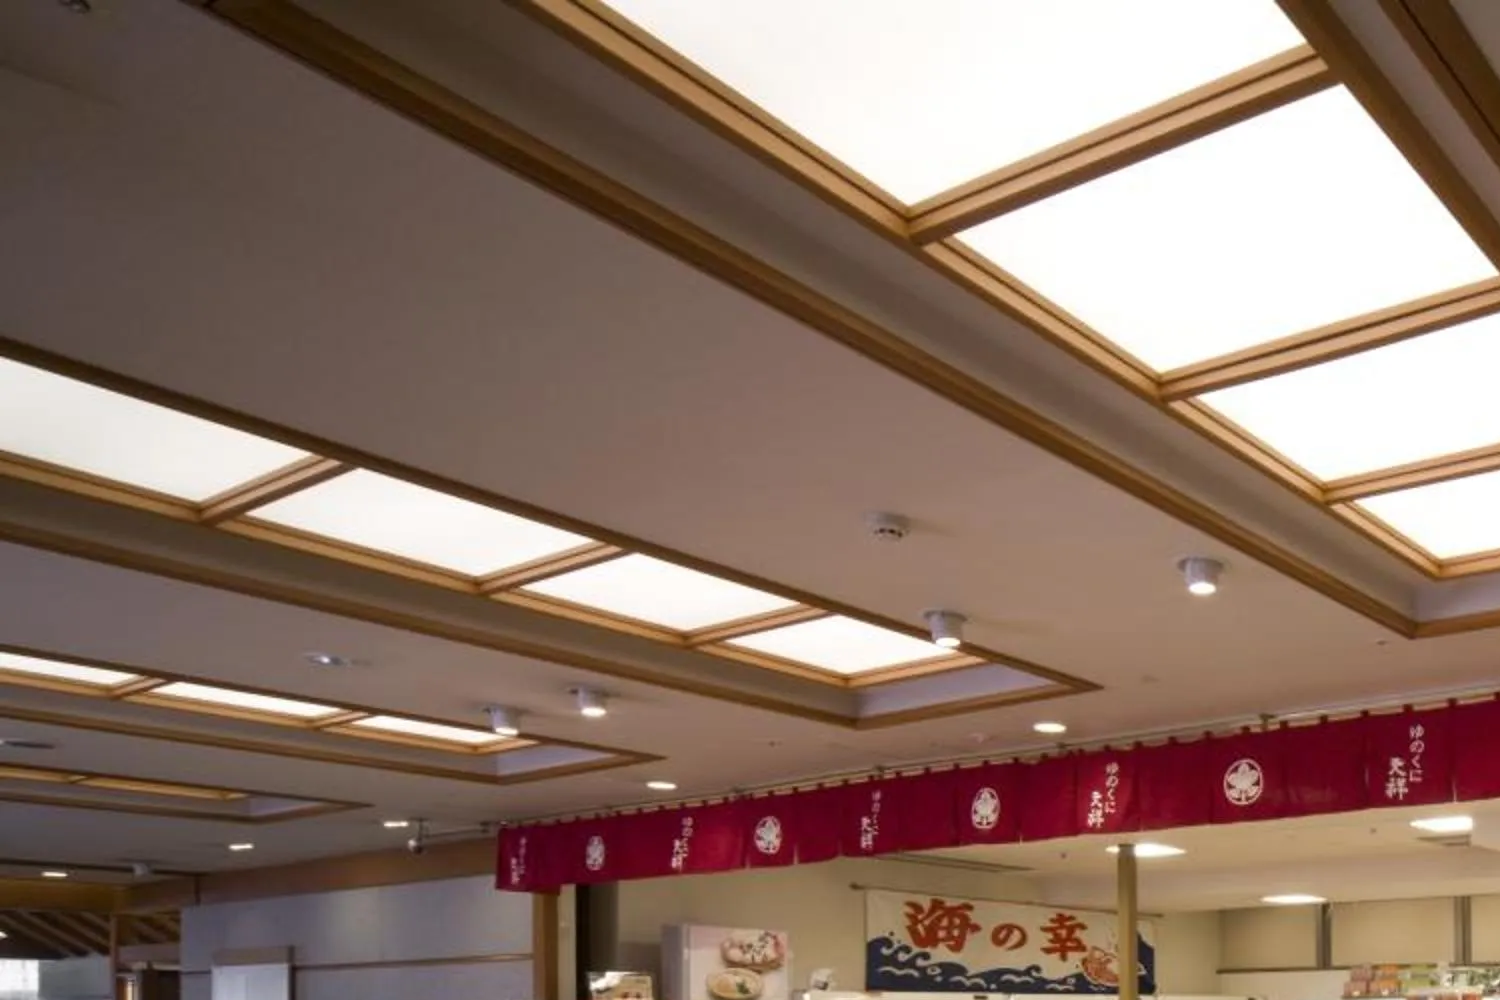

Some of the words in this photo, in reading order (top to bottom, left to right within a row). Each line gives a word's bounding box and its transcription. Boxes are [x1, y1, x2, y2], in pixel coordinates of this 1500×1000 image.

[1409, 724, 1424, 781] ゆのくに
[904, 898, 1088, 962] 海の幸
